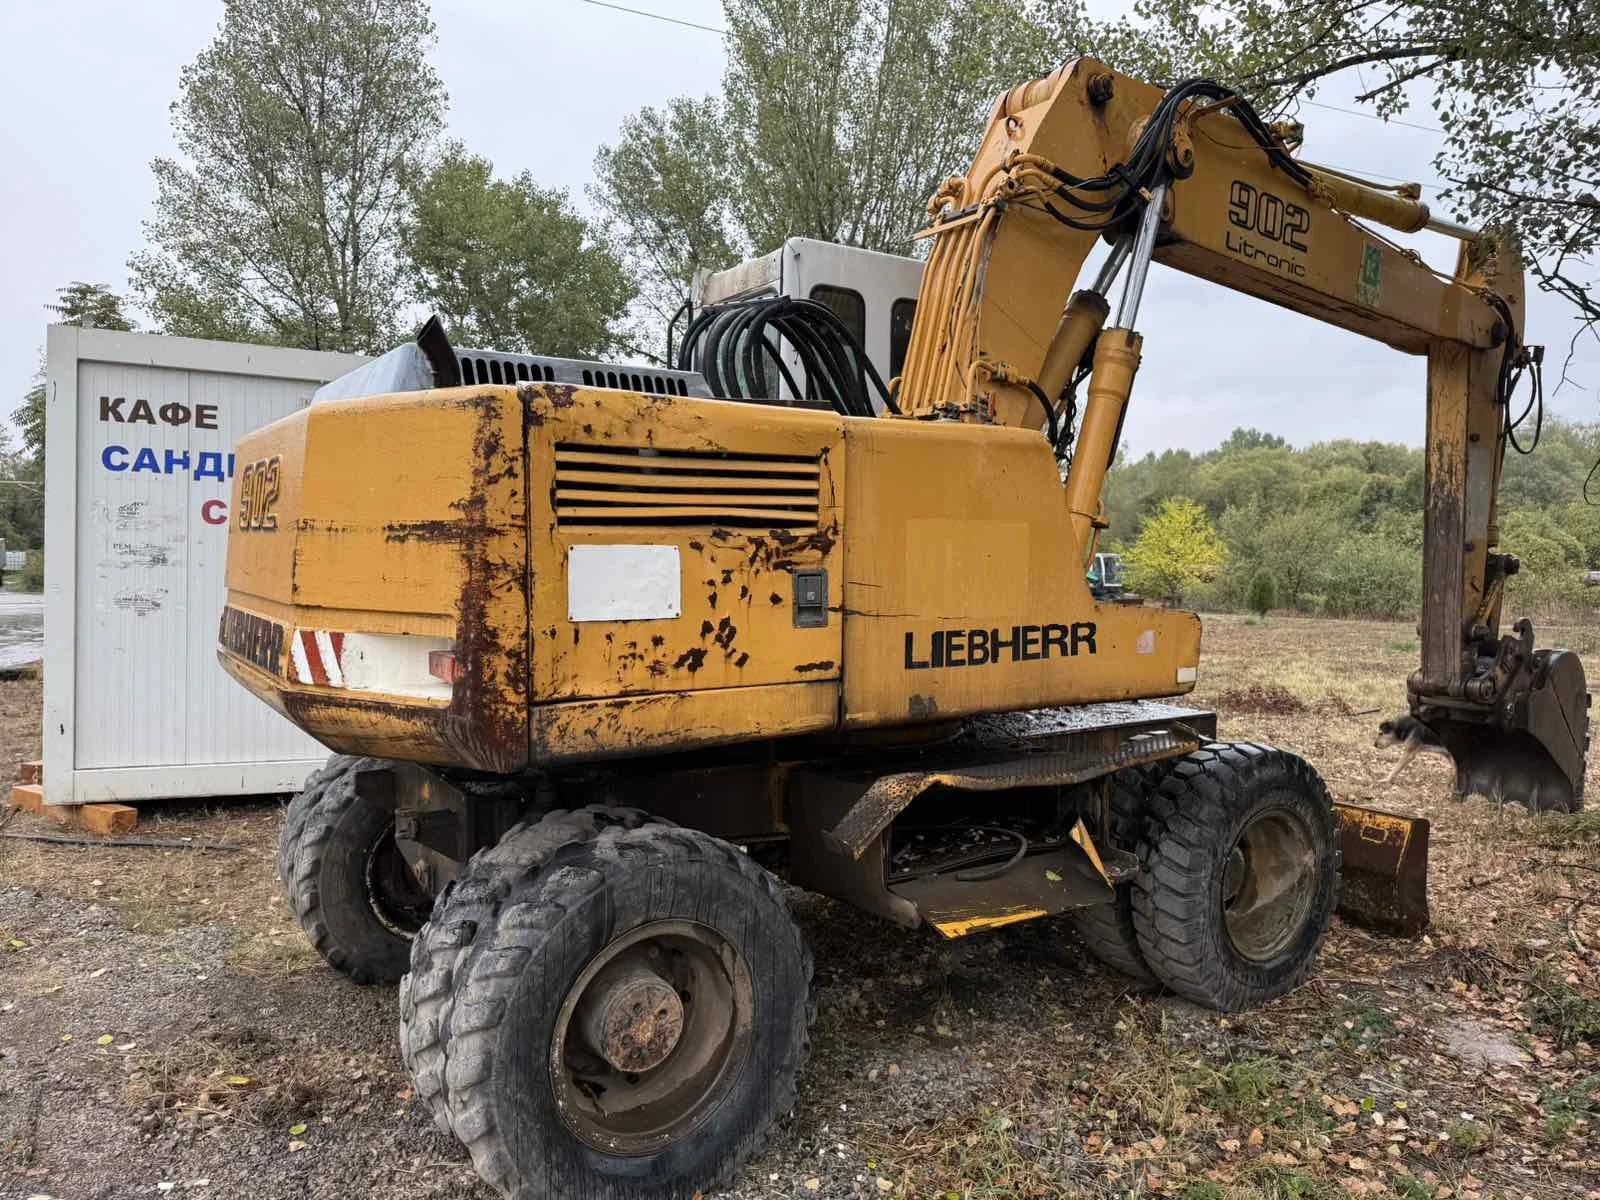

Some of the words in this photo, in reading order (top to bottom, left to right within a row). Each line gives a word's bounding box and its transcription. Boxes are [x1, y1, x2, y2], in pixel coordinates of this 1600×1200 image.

[1228, 179, 1310, 253] 902
[1225, 231, 1305, 278] Litronic
[99, 396, 218, 430] КАФЕ
[239, 455, 281, 531] 902
[904, 622, 1097, 670] LIEBHERR
